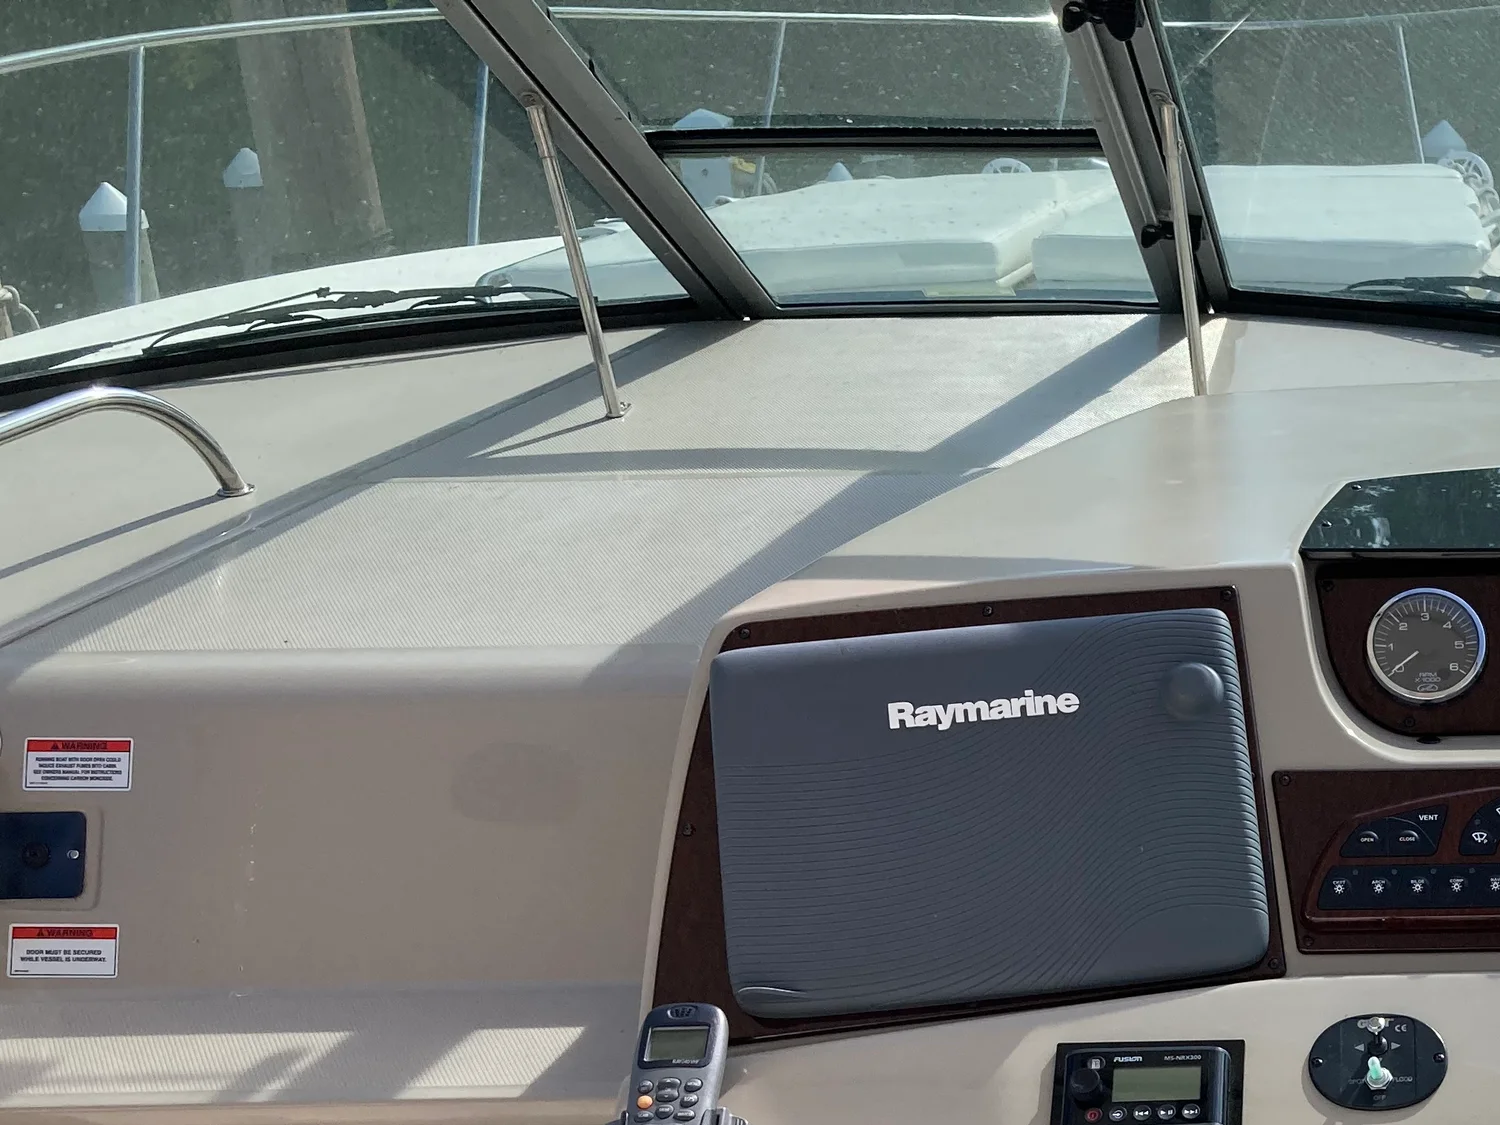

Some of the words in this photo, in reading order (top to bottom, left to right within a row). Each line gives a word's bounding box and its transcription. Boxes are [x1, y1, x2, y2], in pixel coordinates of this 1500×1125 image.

[1421, 613, 1430, 621] 3
[1399, 622, 1408, 631] 2
[1442, 621, 1452, 629] 4
[1388, 643, 1394, 651] 1
[1454, 641, 1465, 649] 5
[1449, 663, 1459, 671] 6
[887, 689, 1080, 731] Raymarine
[47, 929, 93, 938] WARNING
